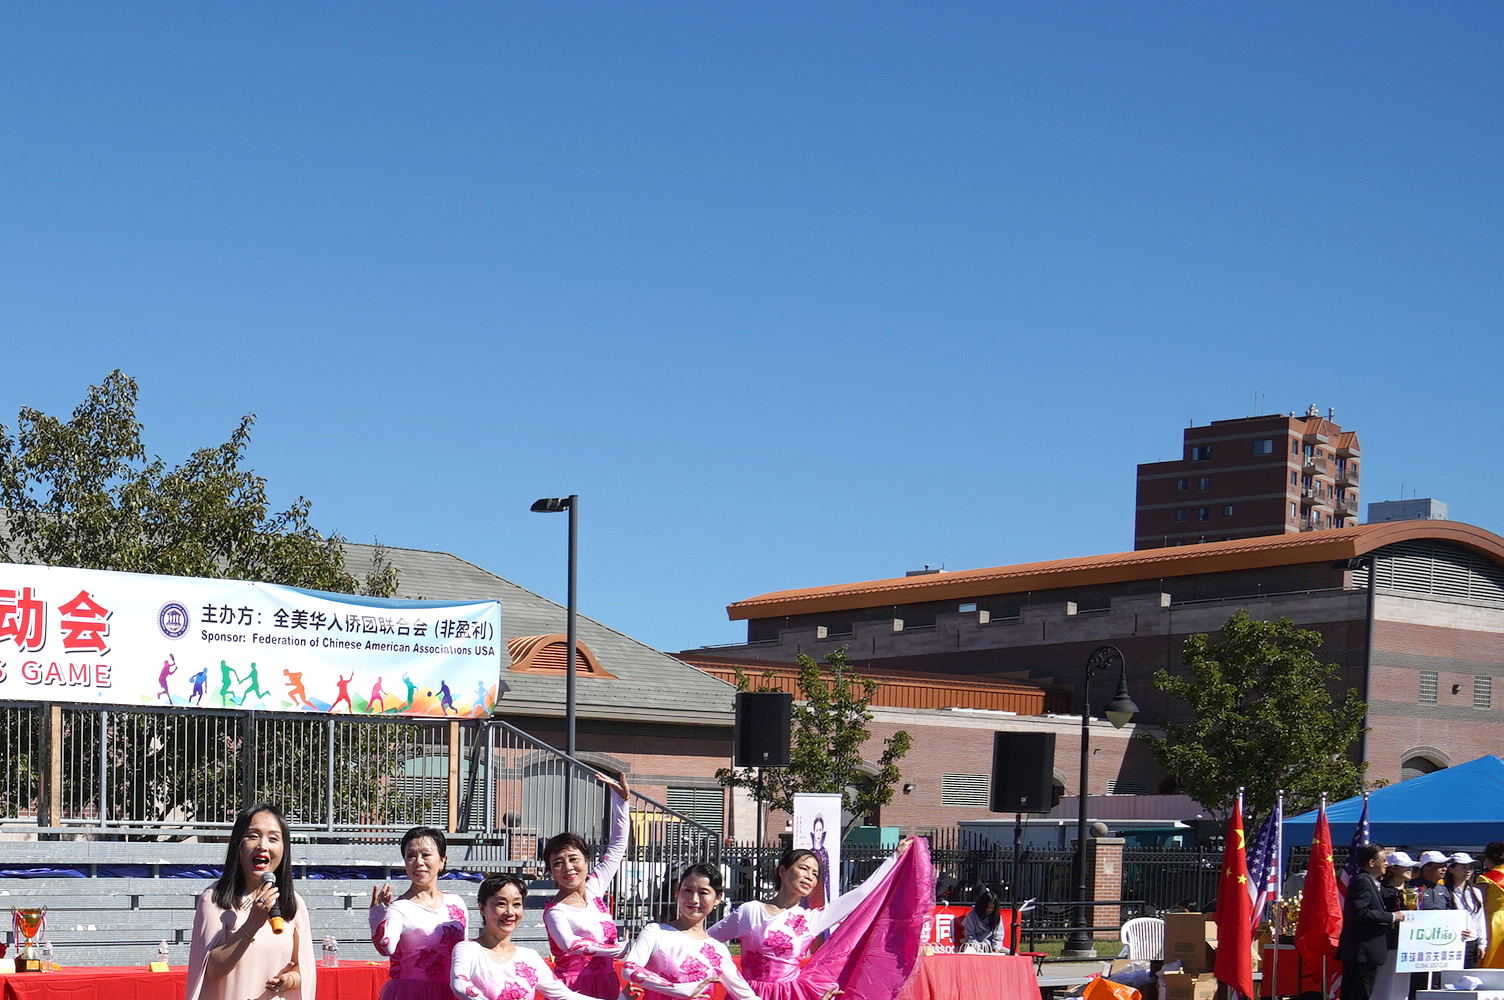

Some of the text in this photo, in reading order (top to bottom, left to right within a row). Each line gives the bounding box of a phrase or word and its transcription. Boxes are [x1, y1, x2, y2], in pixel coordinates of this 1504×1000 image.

[201, 630, 495, 656] Sponsor: Federation of Chinese American Associations USA
[21, 660, 112, 688] GAME
